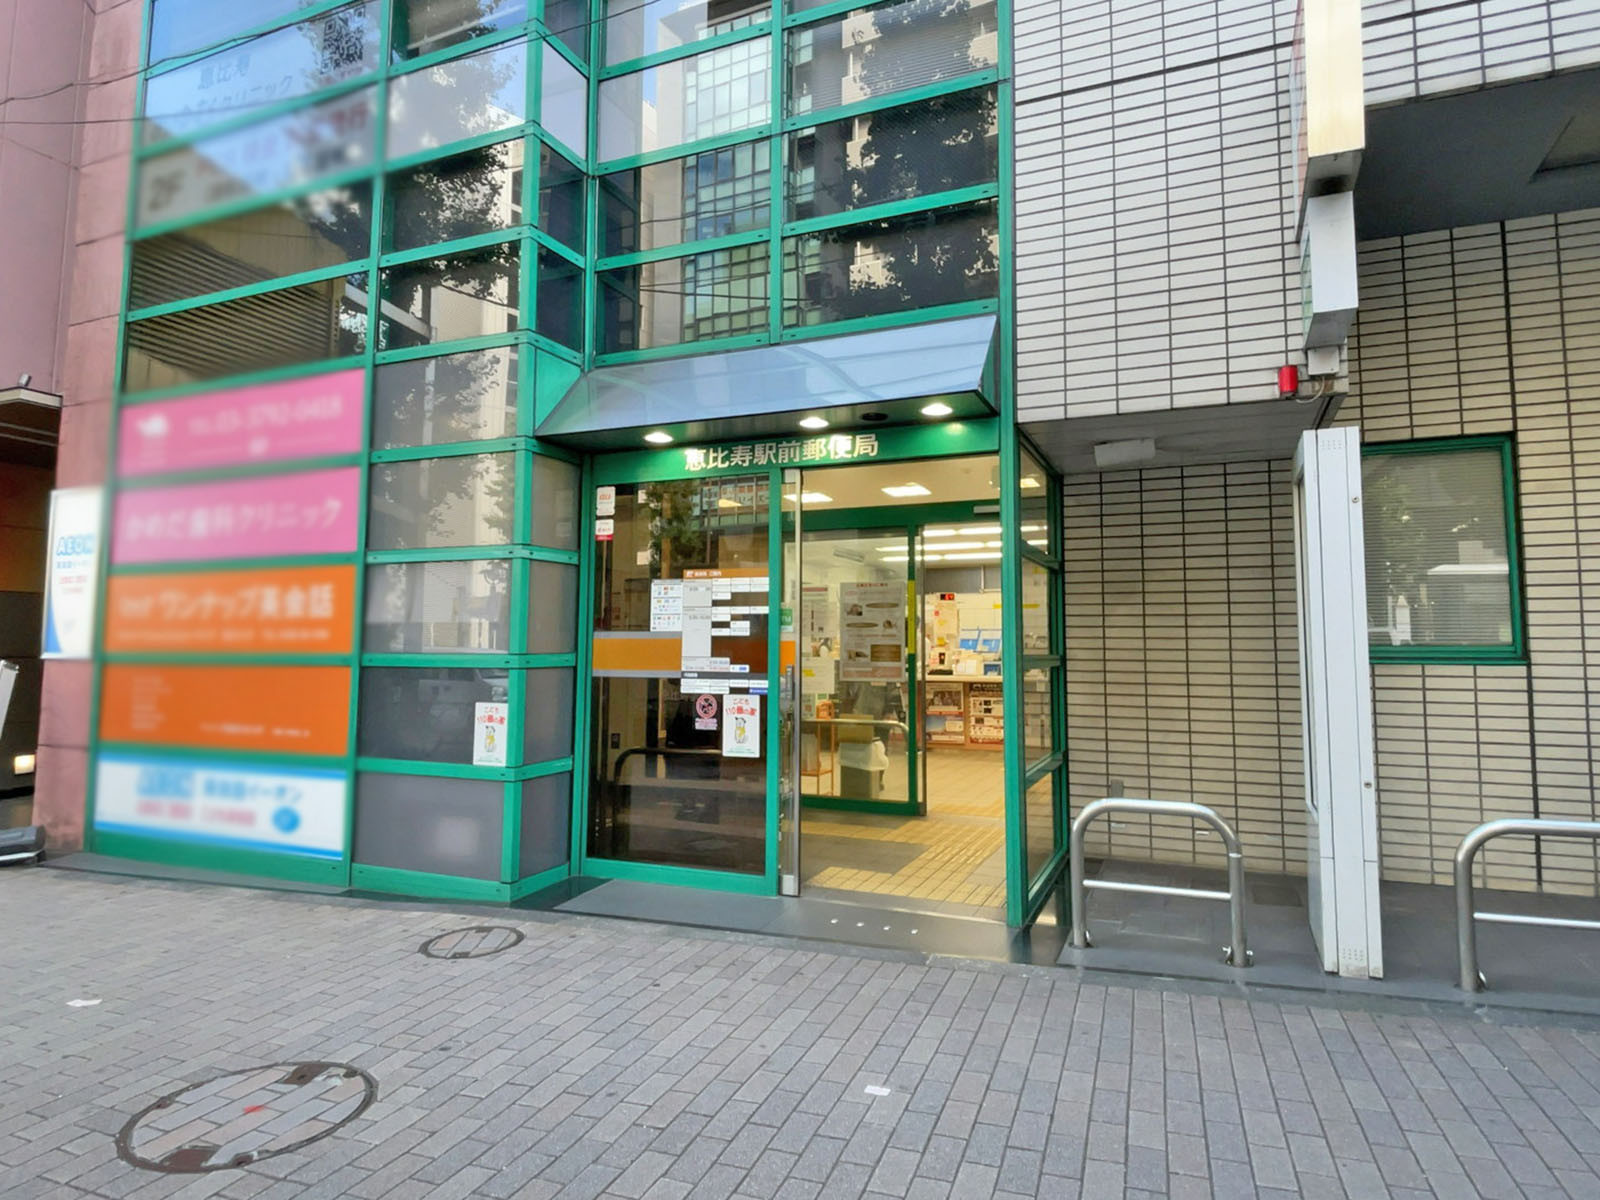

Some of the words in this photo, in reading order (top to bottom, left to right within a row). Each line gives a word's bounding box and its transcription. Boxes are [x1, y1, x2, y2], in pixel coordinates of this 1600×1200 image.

[684, 434, 879, 471] 恵比寿駅前郵便局
